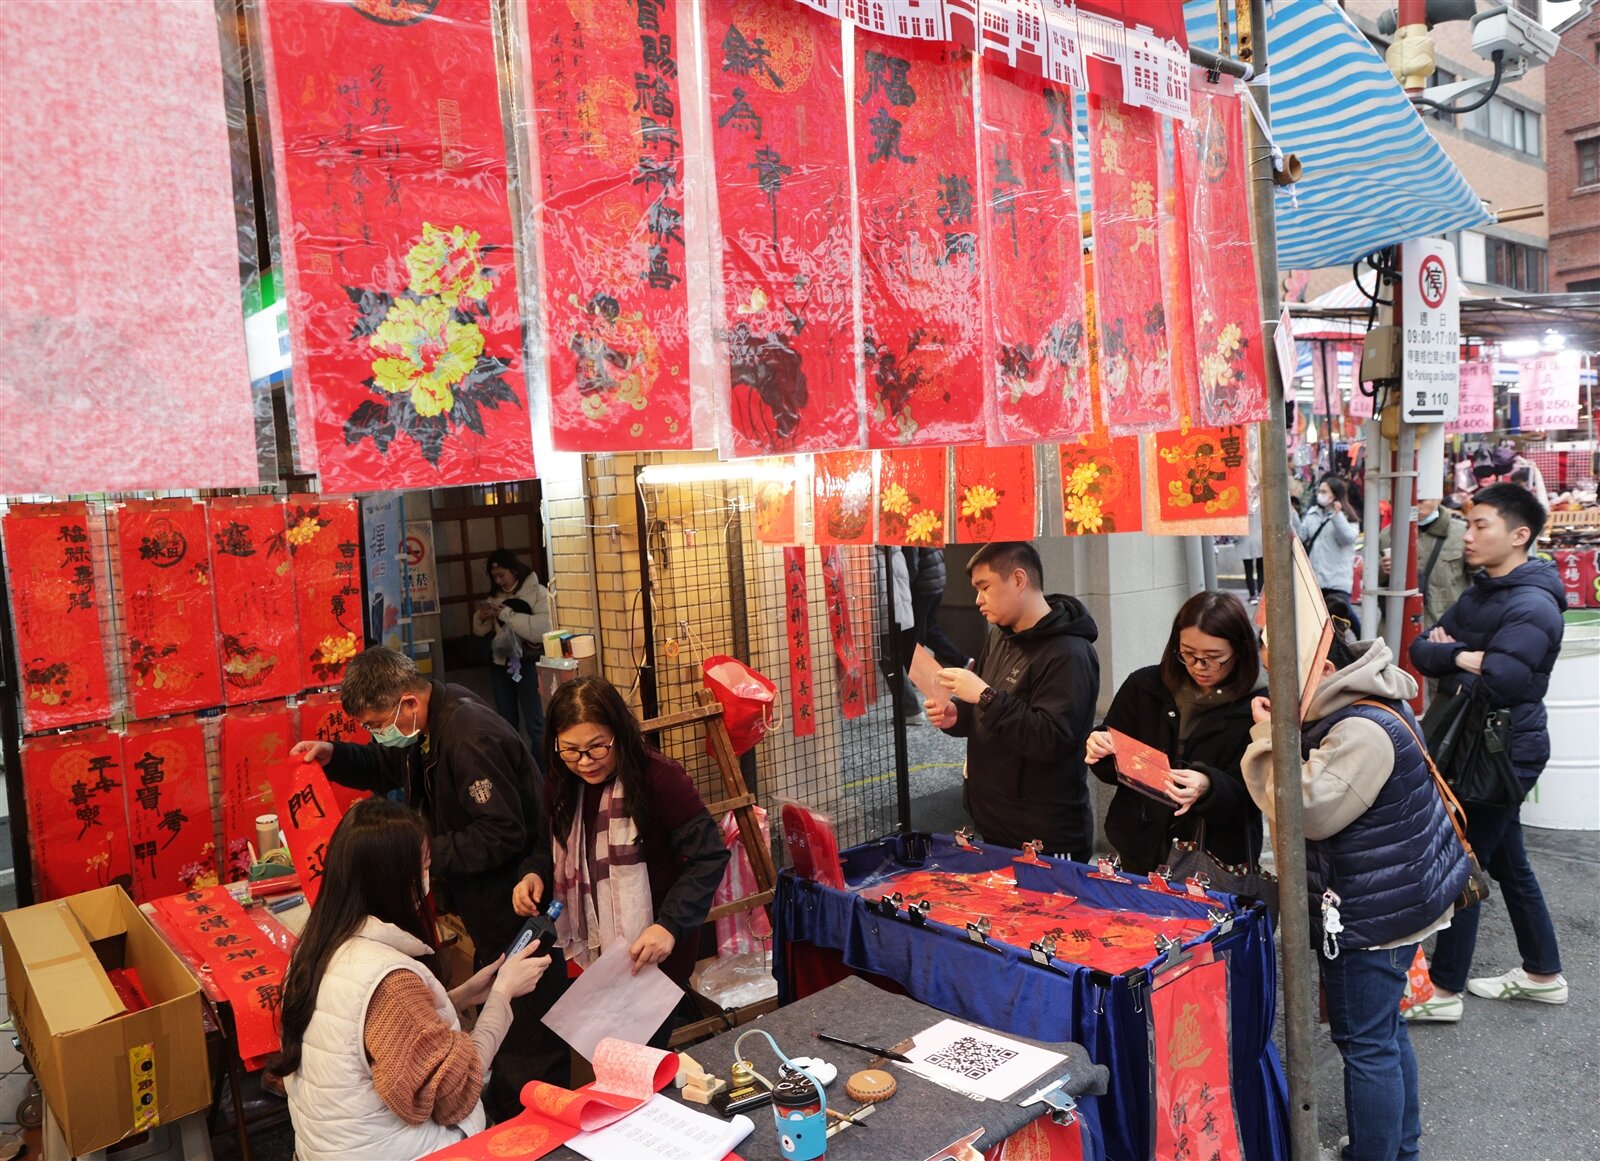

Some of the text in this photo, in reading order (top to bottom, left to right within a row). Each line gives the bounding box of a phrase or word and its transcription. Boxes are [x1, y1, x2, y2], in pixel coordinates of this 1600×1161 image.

[1407, 329, 1458, 345] 09:00-17:00
[1415, 370, 1433, 384] Parking
[1440, 371, 1457, 384] Sunday
[1431, 392, 1449, 406] 110
